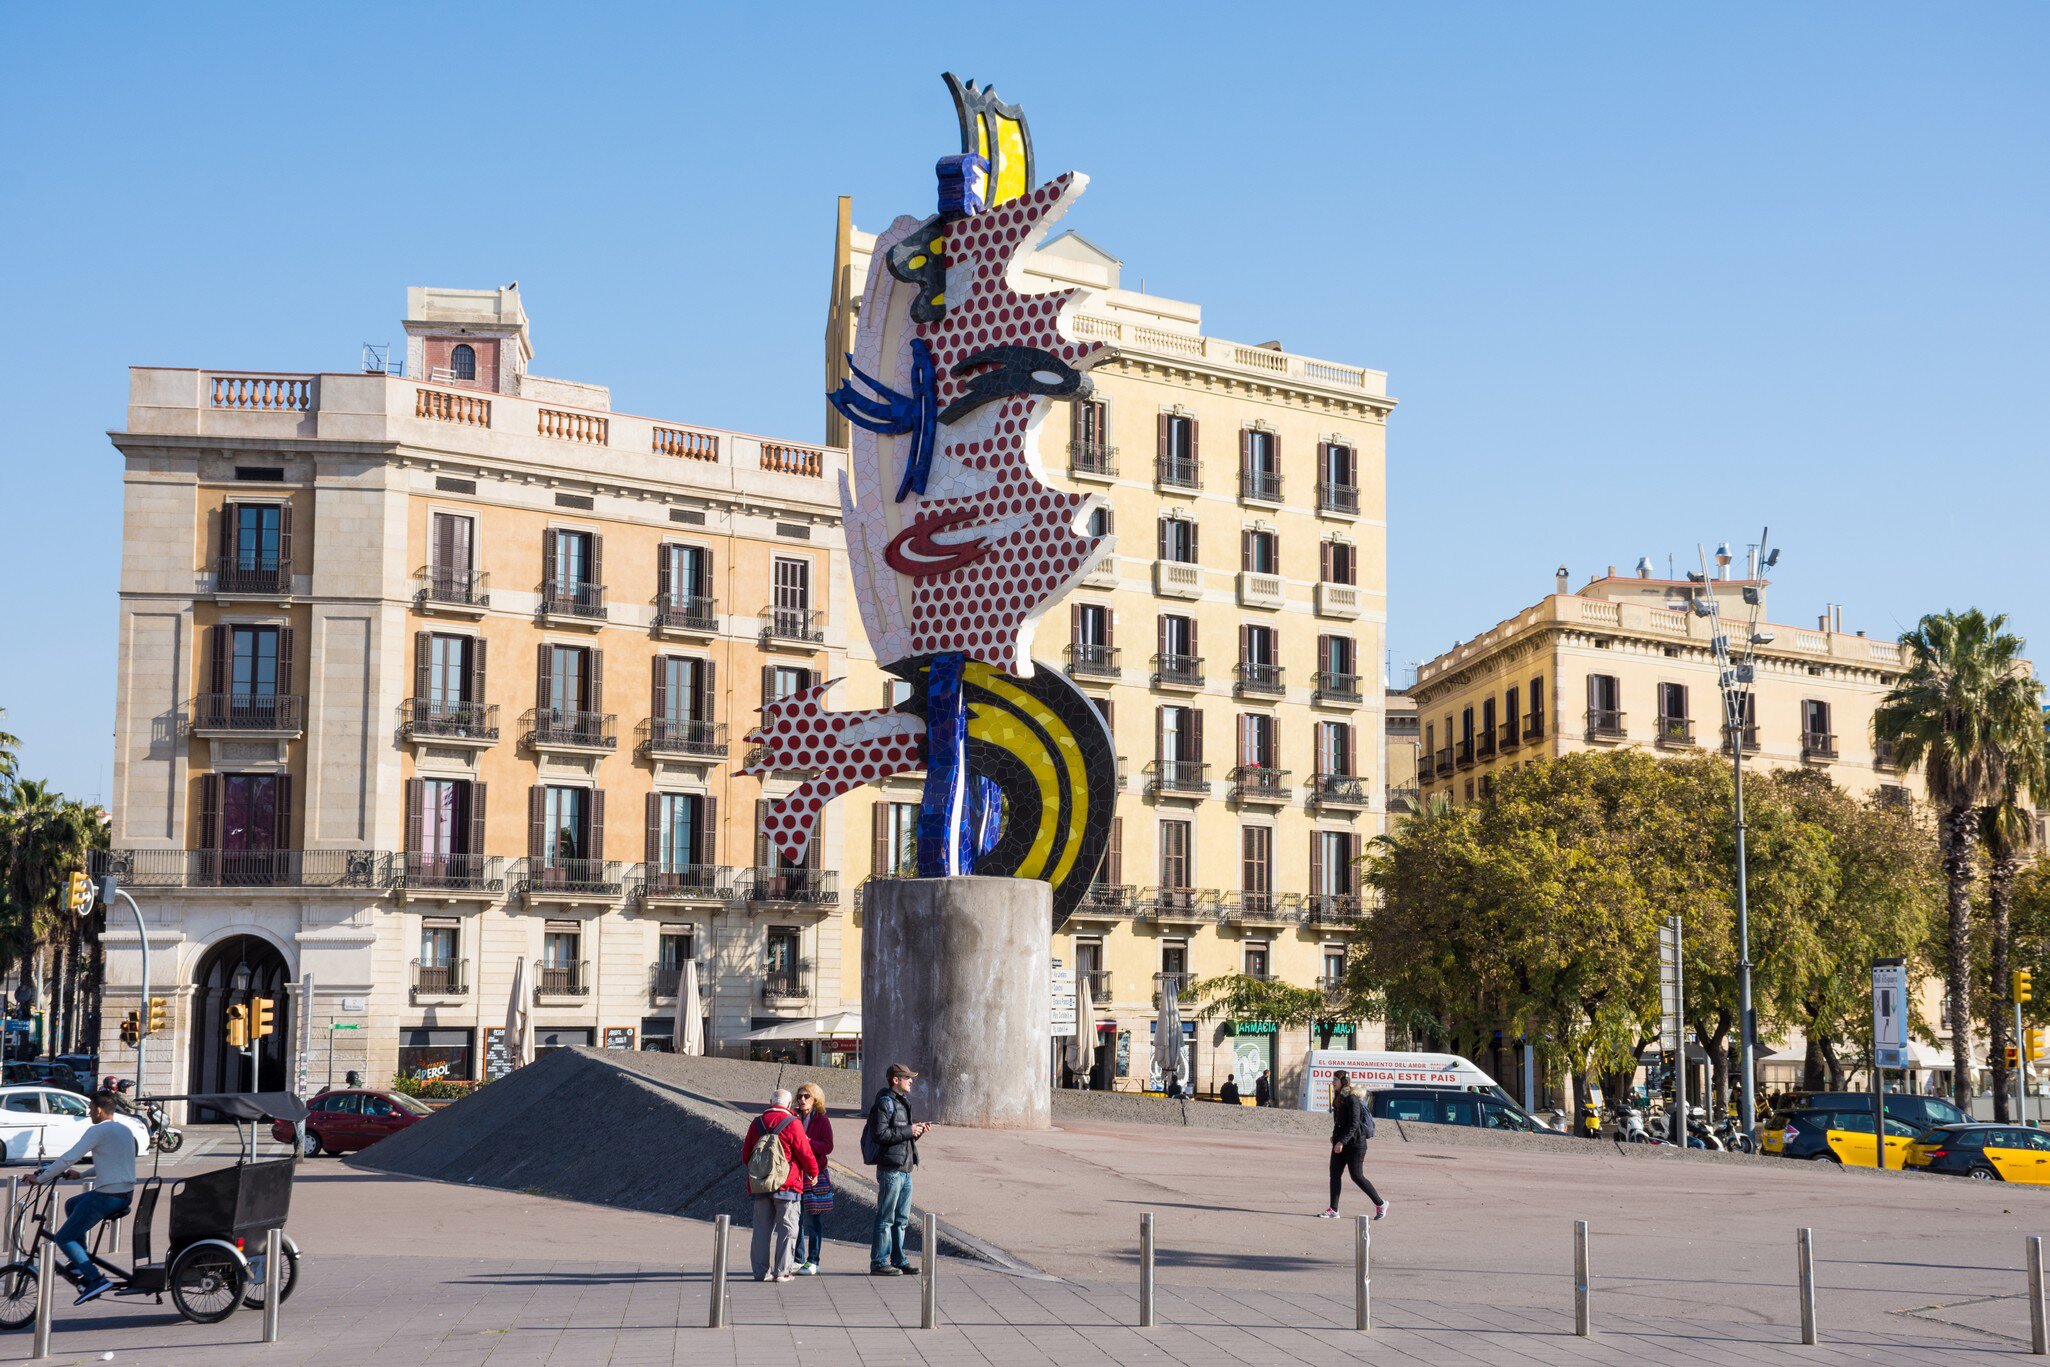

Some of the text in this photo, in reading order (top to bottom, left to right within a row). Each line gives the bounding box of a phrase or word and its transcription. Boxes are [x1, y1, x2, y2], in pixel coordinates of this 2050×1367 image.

[1238, 1021, 1277, 1033] ARMACIA
[414, 1065, 450, 1080] APEROL
[1313, 1070, 1456, 1082] DIO ENDIGA ESTE PAIS
